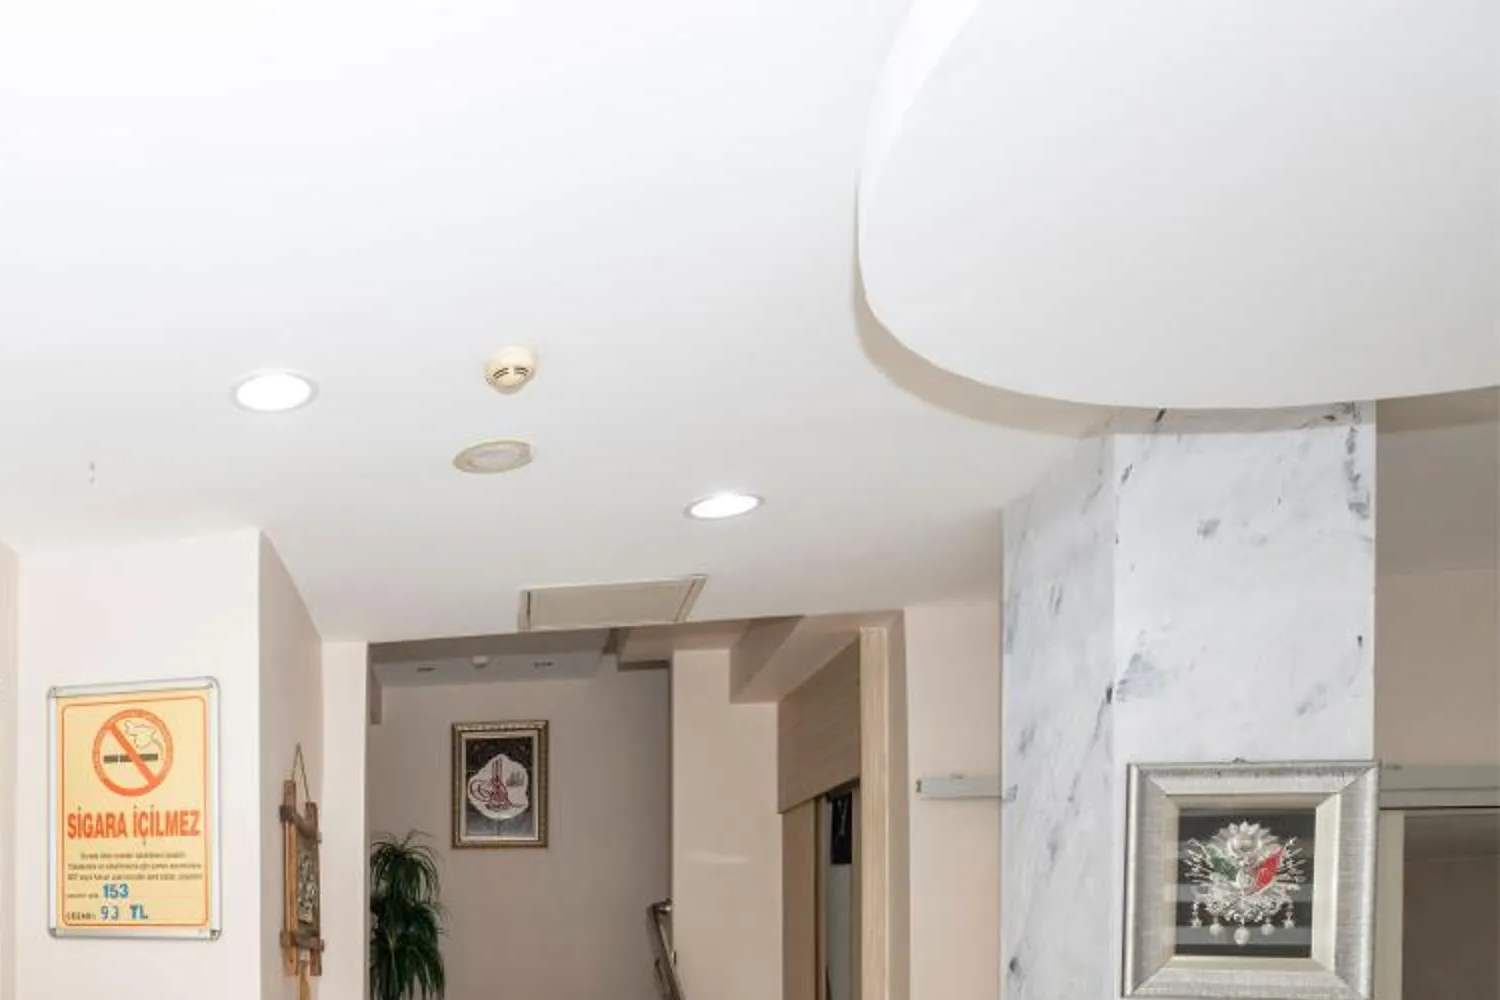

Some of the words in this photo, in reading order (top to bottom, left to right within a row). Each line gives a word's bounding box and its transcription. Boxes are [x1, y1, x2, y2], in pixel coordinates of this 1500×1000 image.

[67, 805, 128, 840] SİGARA
[133, 804, 201, 846] İÇİLMEZ
[103, 882, 129, 899] 153
[129, 904, 148, 920] TL
